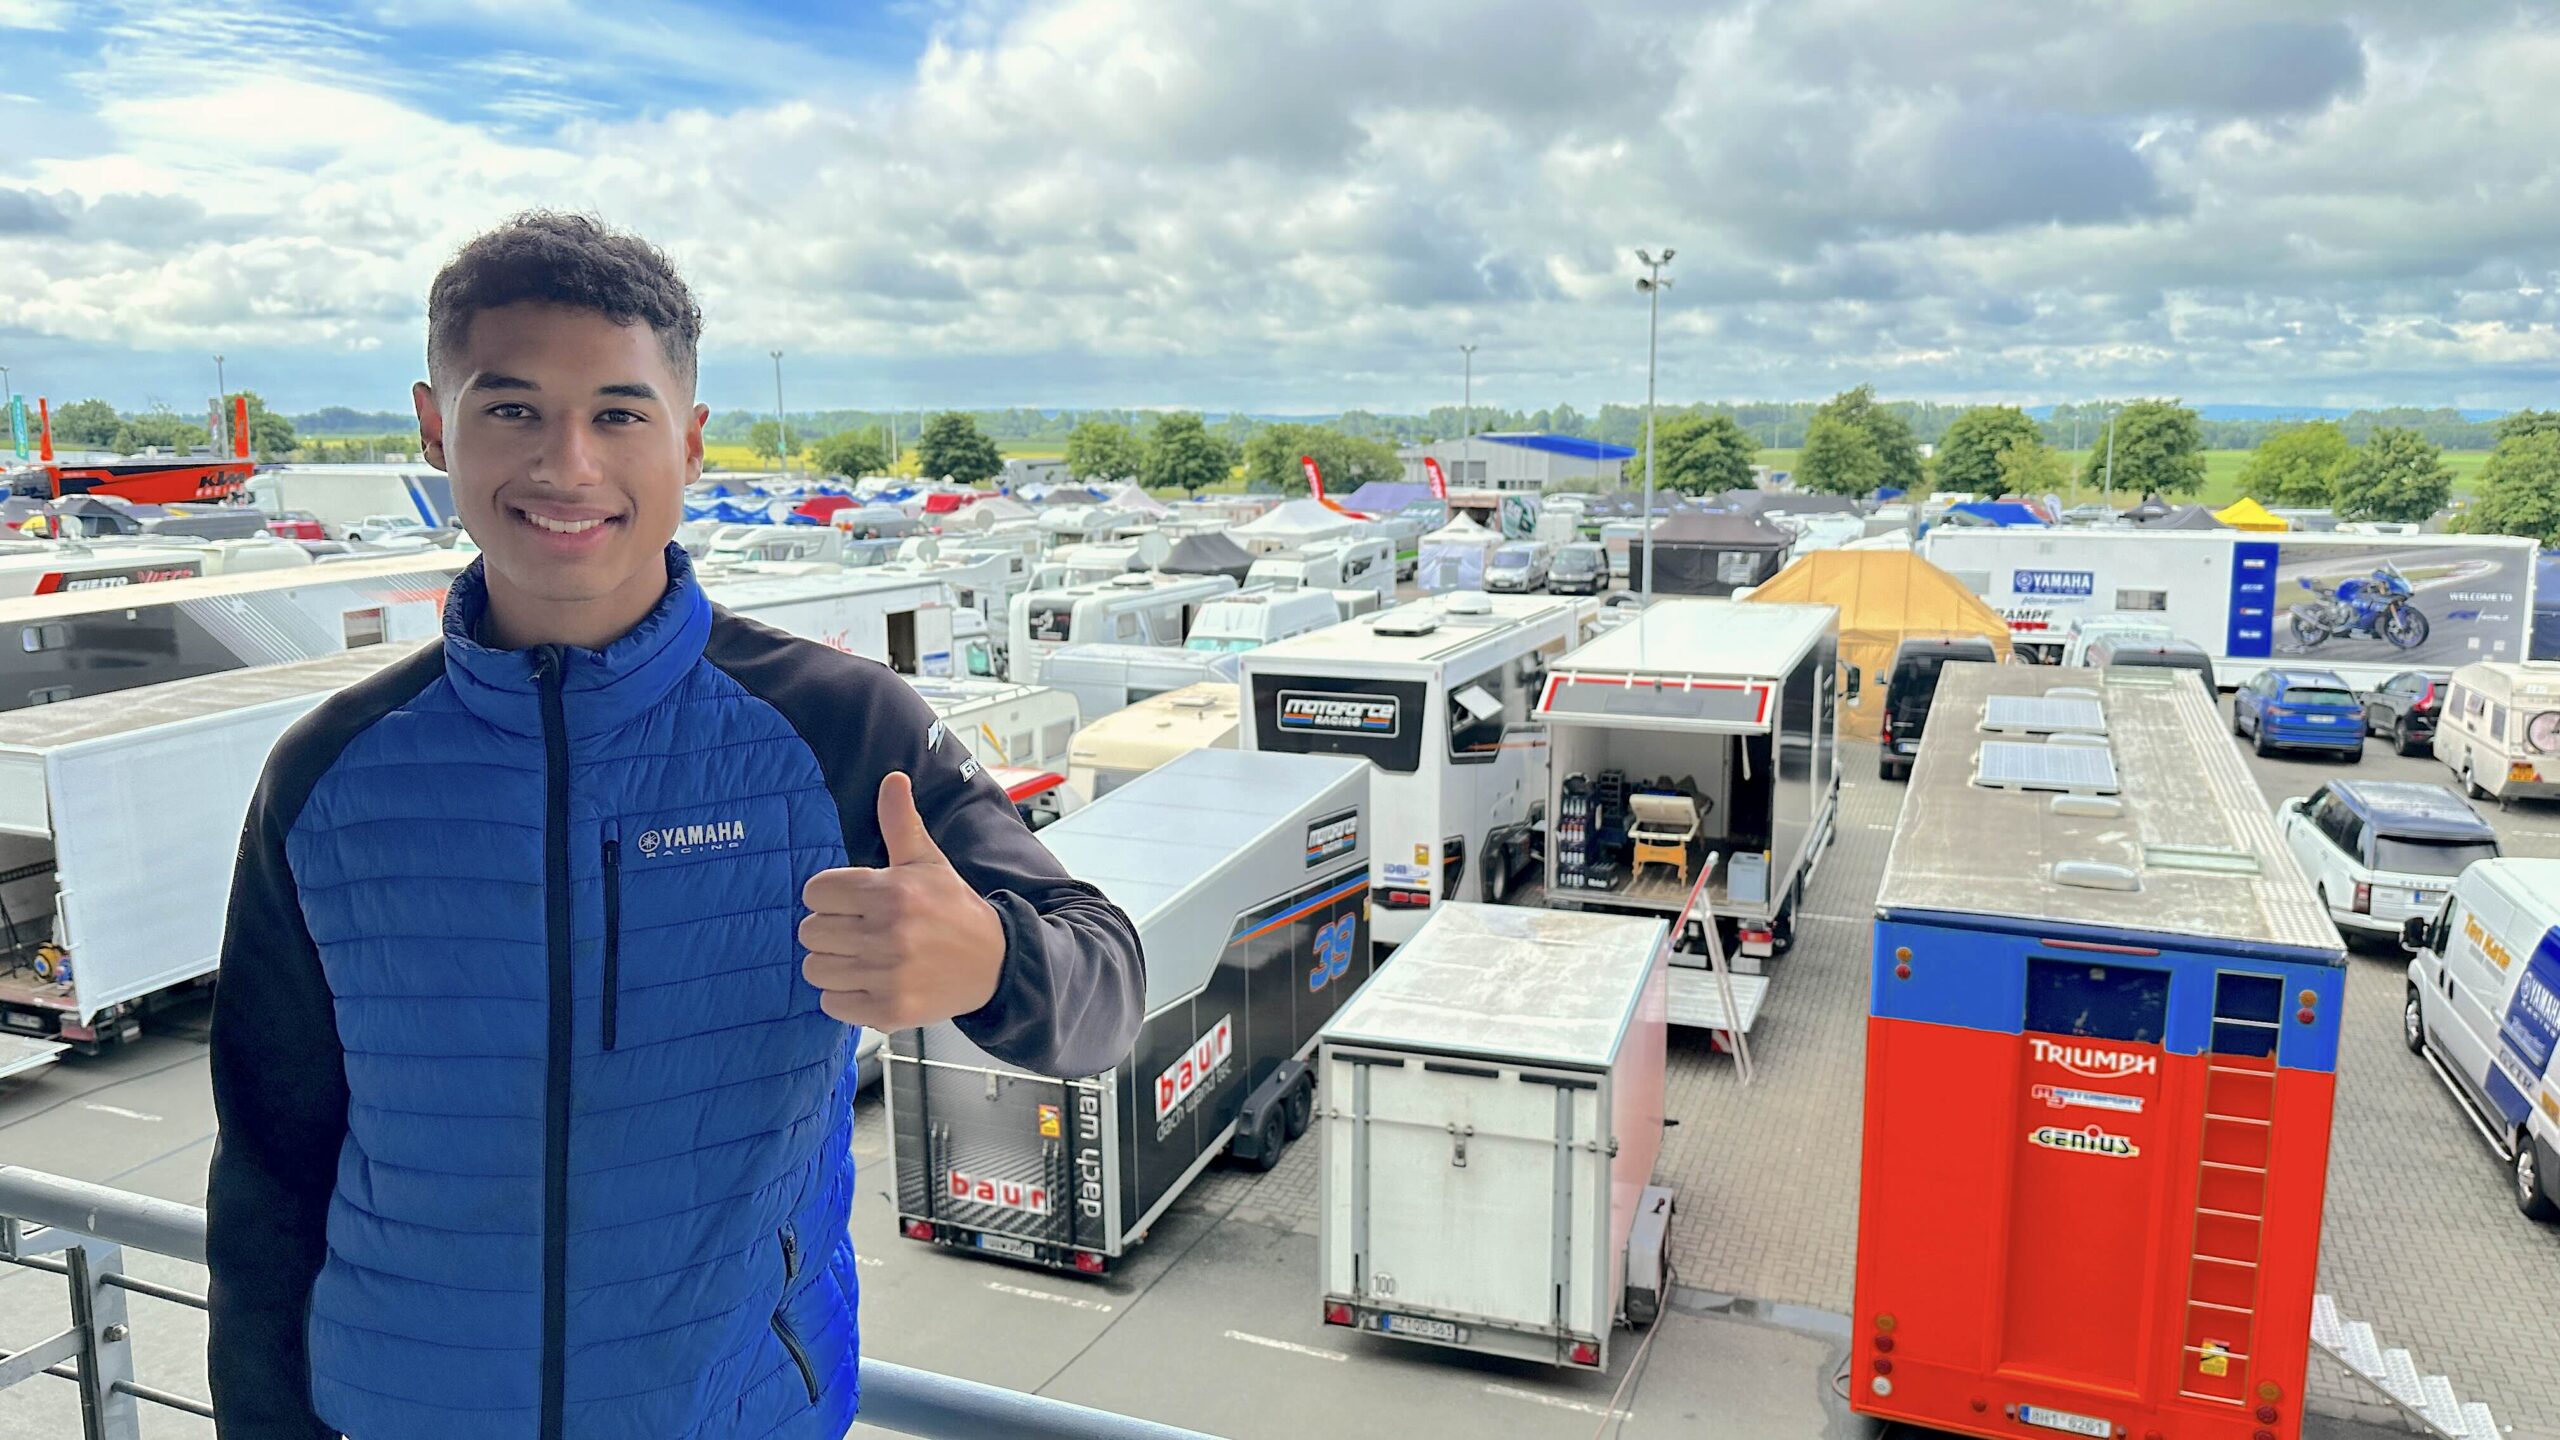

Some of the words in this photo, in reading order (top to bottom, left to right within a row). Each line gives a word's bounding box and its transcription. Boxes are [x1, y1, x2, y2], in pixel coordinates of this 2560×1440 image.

[2033, 573, 2090, 588] YAMAHA
[2449, 592, 2497, 601] WELCOME
[2500, 593, 2513, 602] TO
[1314, 715, 1362, 727] RACING
[646, 842, 739, 859] RACING
[661, 821, 745, 848] YAMAHA
[1309, 912, 1356, 993] 39
[1160, 1025, 1228, 1112] baur
[2029, 1039, 2157, 1078] TRIUMPH
[1078, 1077, 1099, 1140] wan
[1156, 1104, 1186, 1142] dach
[951, 1169, 1047, 1209] baur
[1075, 1147, 1101, 1218] dach
[1374, 1275, 1396, 1295] 100
